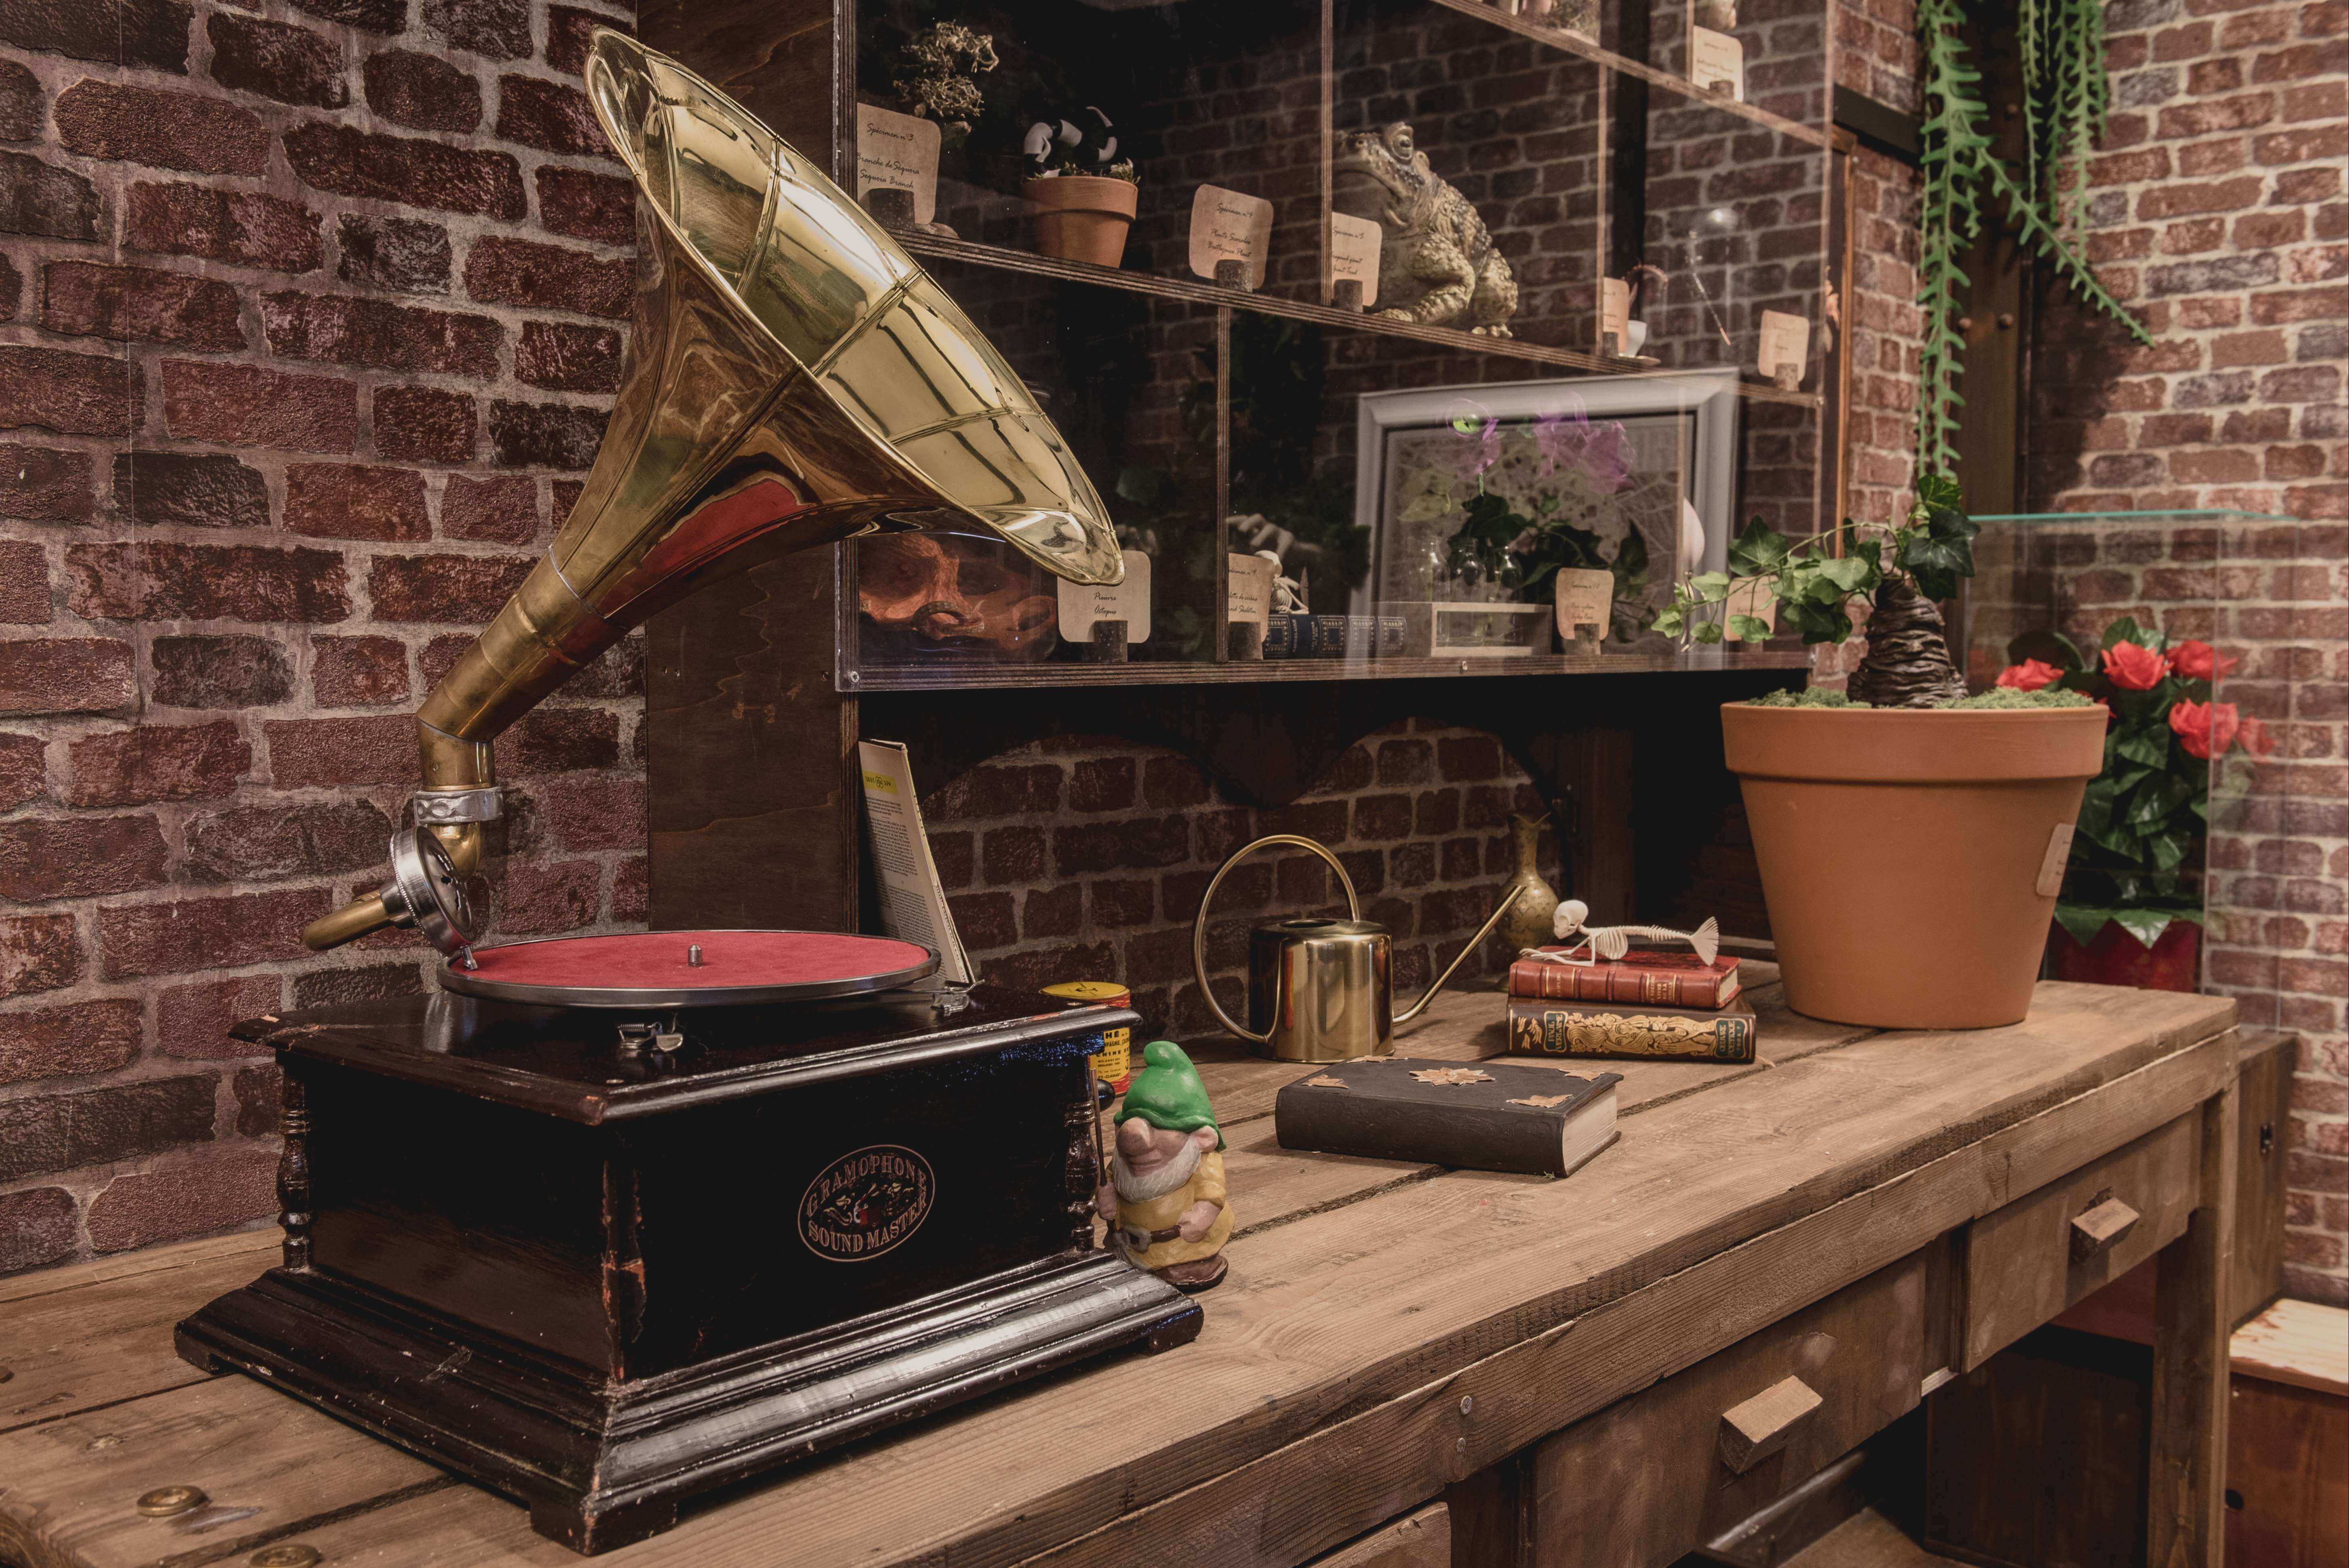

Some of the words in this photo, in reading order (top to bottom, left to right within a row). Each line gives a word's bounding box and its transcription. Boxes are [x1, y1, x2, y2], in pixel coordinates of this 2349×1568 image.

[867, 123, 898, 138] Spécimen
[857, 152, 884, 166] Branche
[893, 162, 919, 176] Séquoia
[860, 169, 886, 183] Sequoia
[889, 176, 914, 188] Branch
[1094, 592, 1117, 601] Pieuvre
[1094, 605, 1117, 617] Octopus
[806, 1155, 926, 1217] GRAMOPHONE
[808, 1220, 863, 1252] SOUND
[867, 1192, 927, 1250] MASTER
